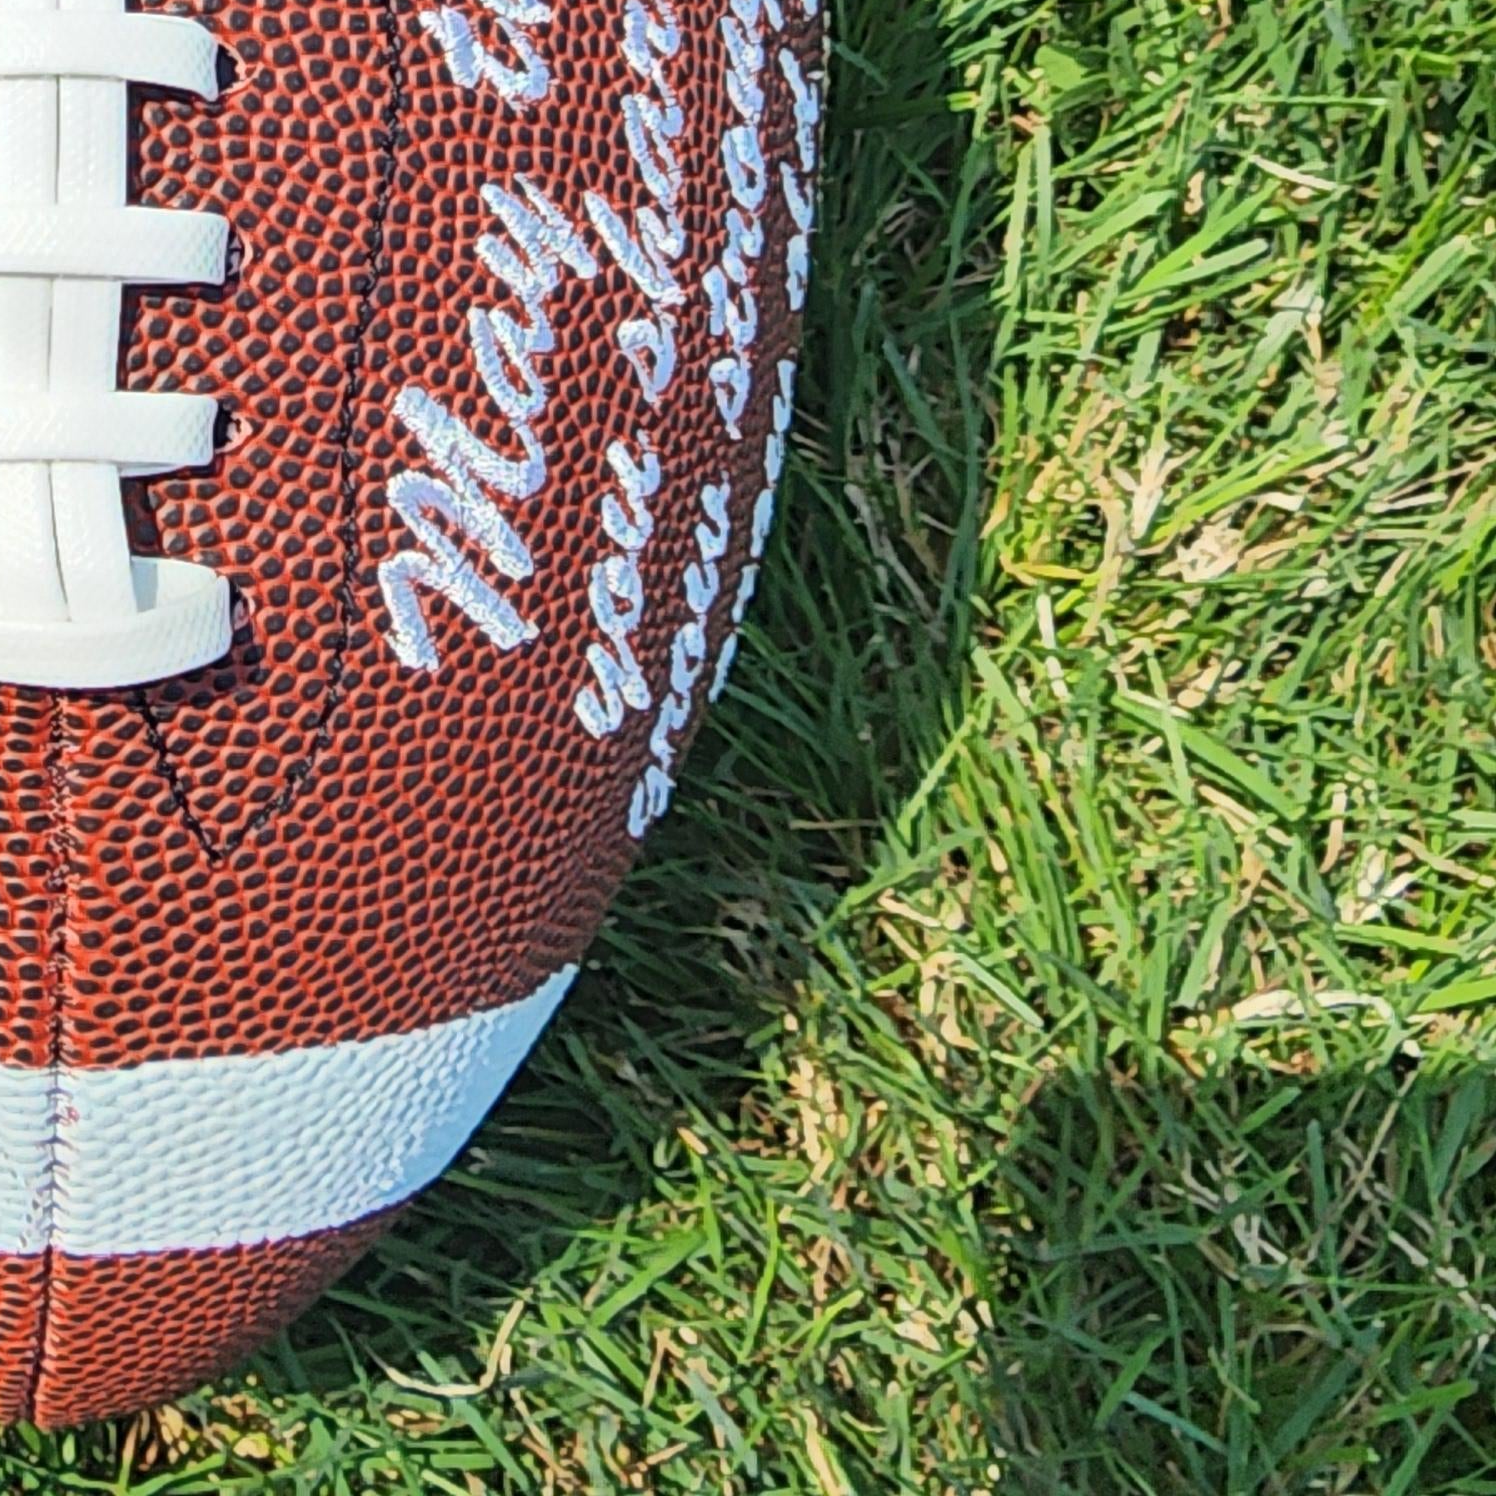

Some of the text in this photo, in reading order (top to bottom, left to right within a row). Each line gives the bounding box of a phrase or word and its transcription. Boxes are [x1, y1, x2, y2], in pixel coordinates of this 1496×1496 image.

[378, 172, 599, 672] May
[574, 428, 662, 740] you
[627, 469, 731, 840] grow
